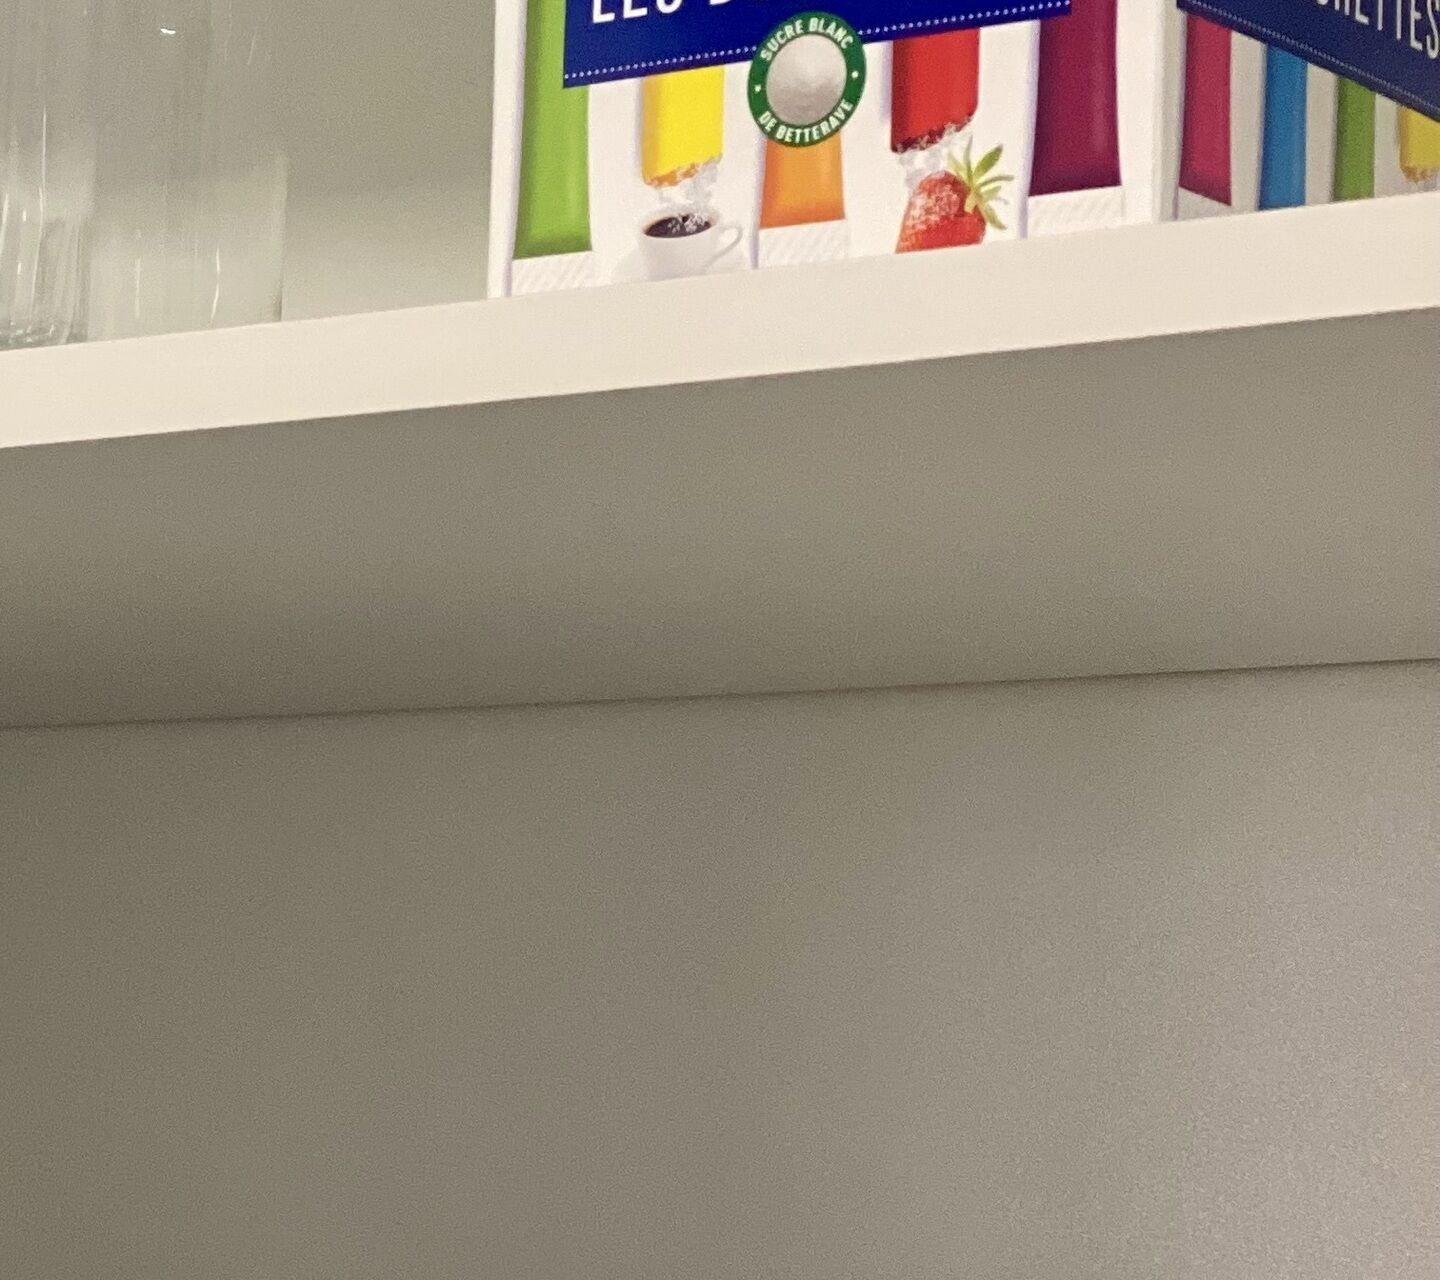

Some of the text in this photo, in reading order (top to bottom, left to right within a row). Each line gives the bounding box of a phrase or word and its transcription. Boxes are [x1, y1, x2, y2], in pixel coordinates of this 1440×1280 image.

[760, 17, 854, 62] SUCRE BLANC
[759, 99, 854, 144] DE BETTERAVE
